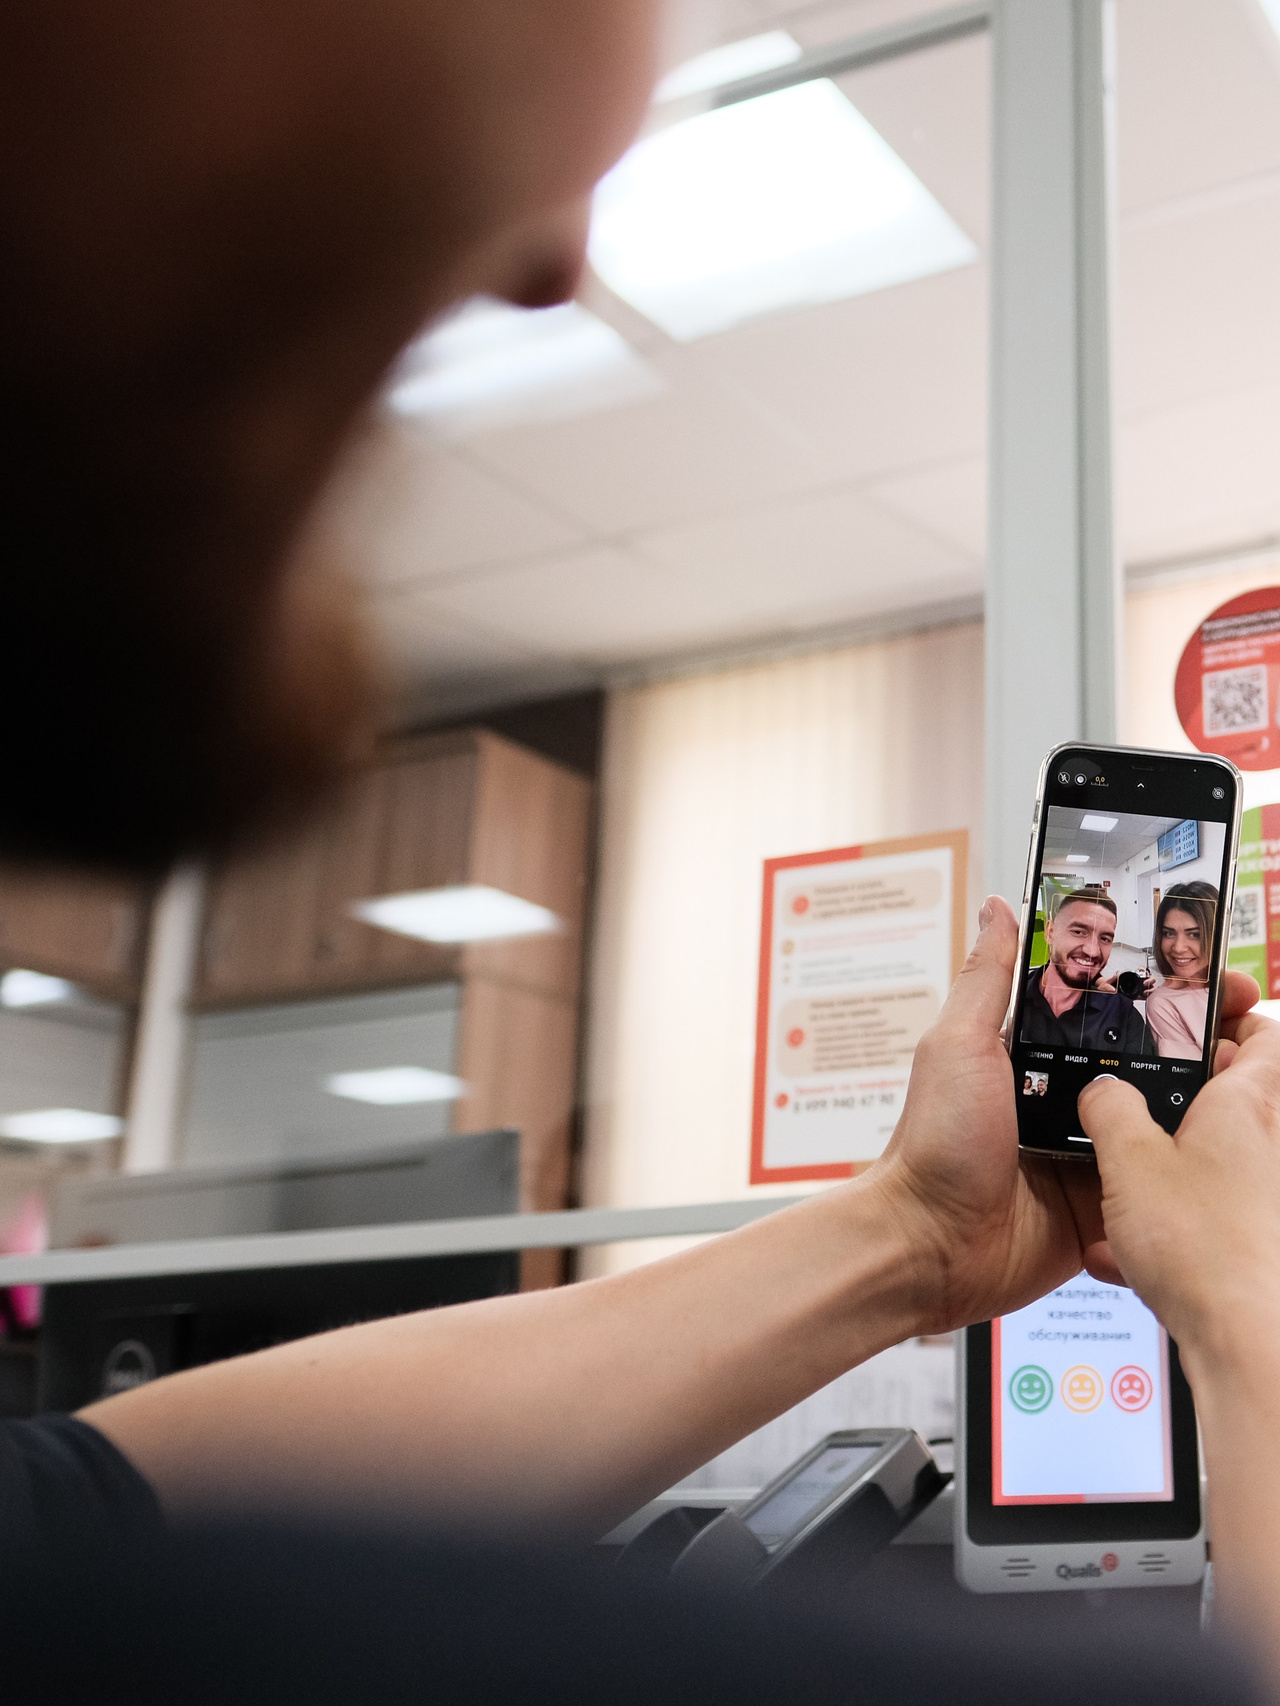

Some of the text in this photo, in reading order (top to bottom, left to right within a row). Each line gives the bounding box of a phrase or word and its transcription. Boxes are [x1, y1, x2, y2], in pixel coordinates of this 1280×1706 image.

[1065, 1054, 1088, 1063] ВИДЕО
[1099, 1059, 1119, 1067] ФОТО
[1131, 1061, 1161, 1071] ПОРТРЕТ
[1048, 1288, 1123, 1303] жалуйста,
[1047, 1311, 1112, 1321] качество
[1028, 1328, 1132, 1344] обслуживания
